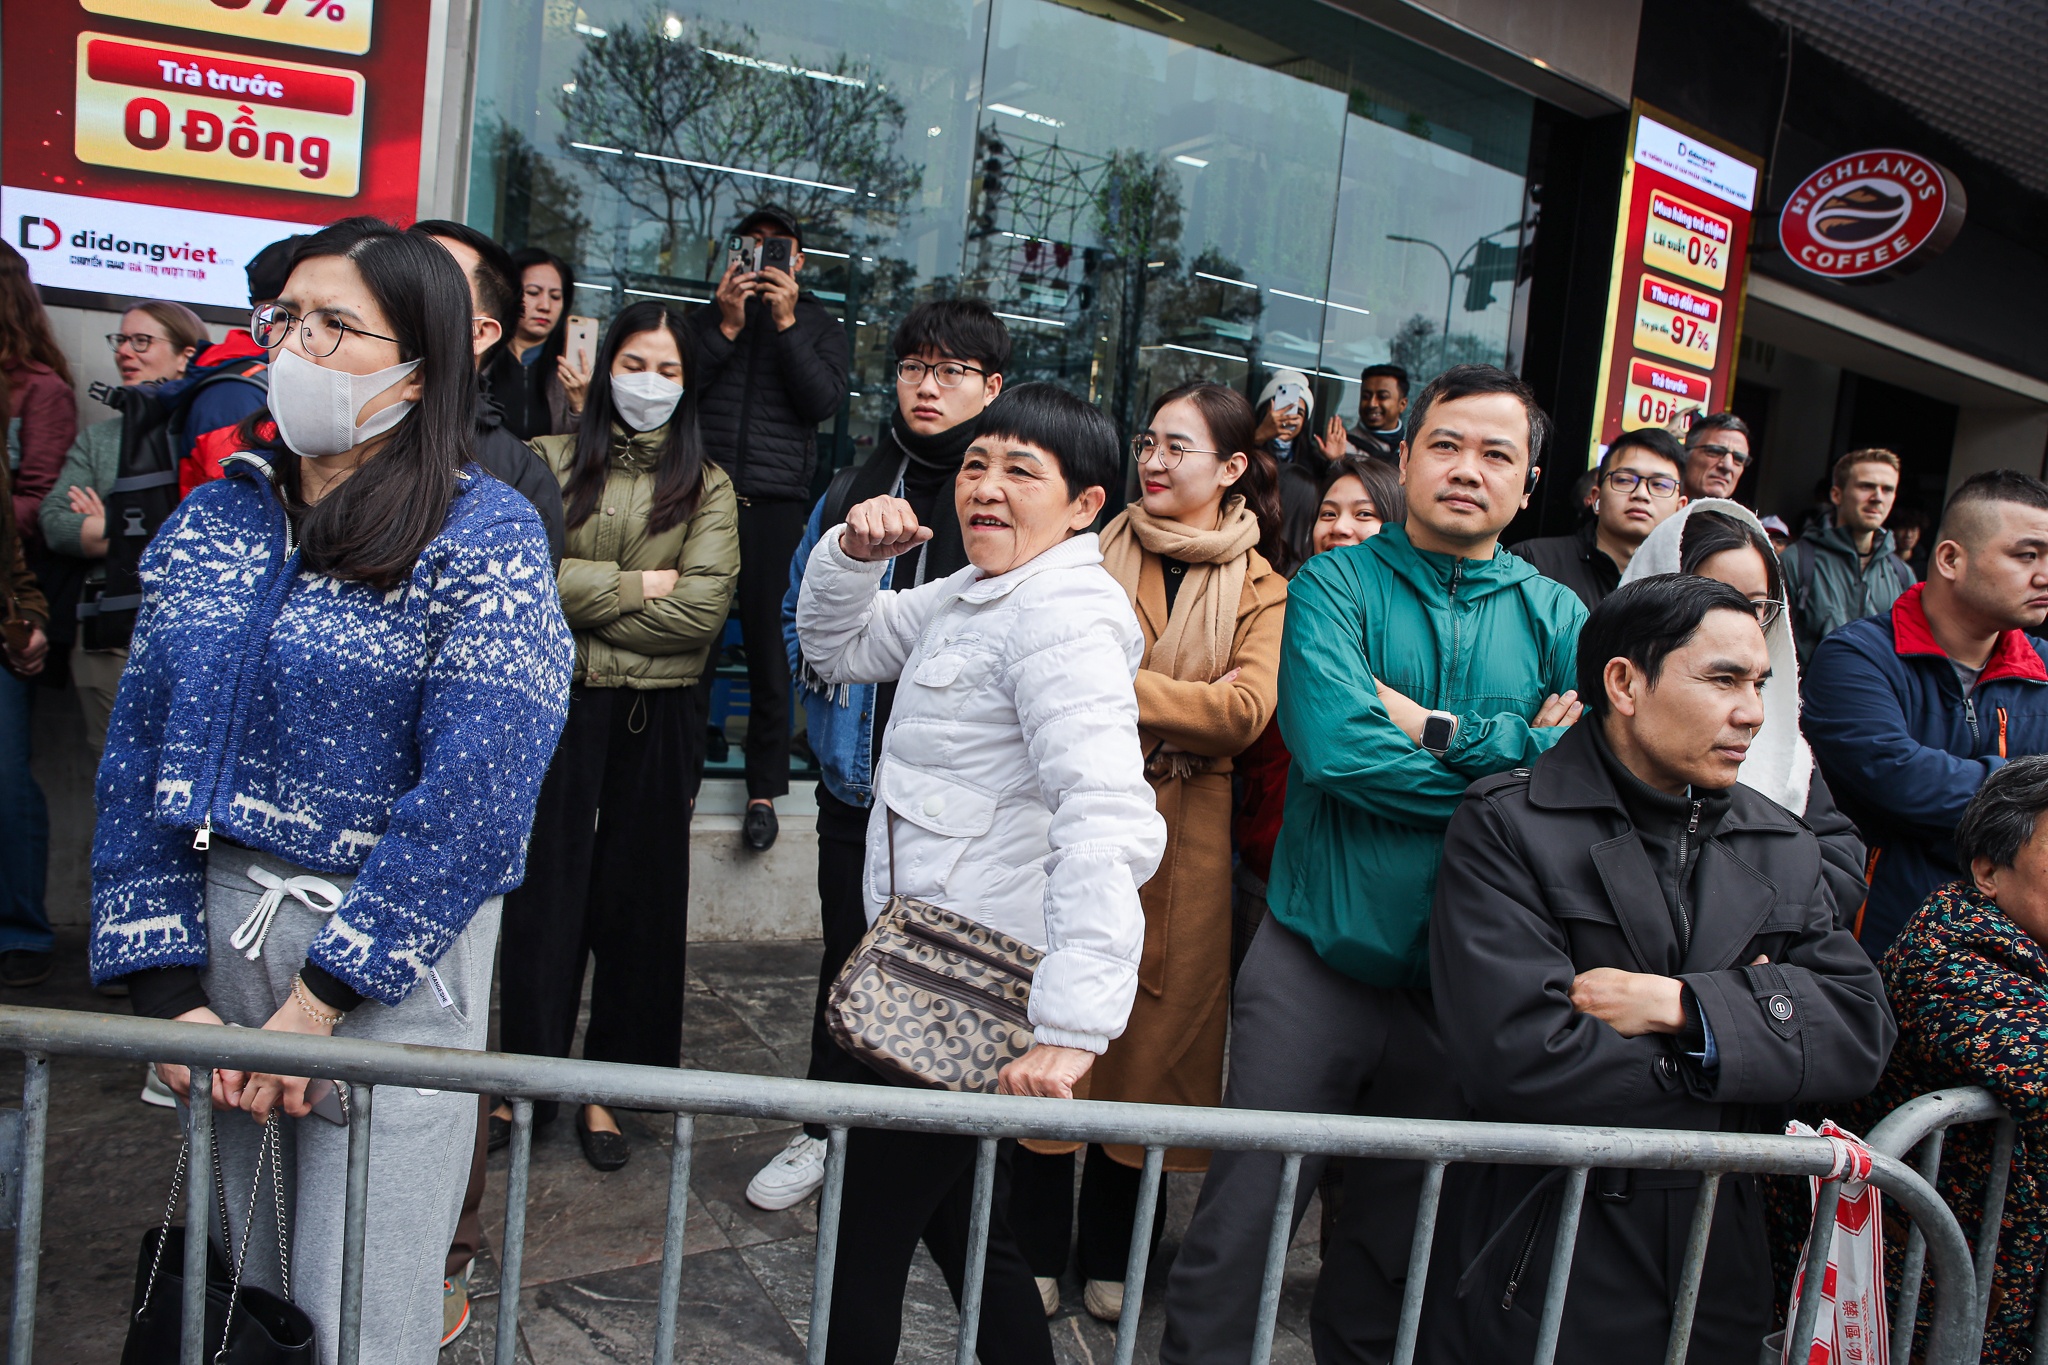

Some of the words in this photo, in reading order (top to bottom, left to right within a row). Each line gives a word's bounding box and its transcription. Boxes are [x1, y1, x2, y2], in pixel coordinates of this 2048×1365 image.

[158, 60, 202, 87] Trả
[207, 66, 284, 98] trước
[125, 97, 171, 151] 0
[181, 104, 331, 180] Đồng
[1791, 157, 1937, 215] HIGHLANDS
[1653, 199, 1672, 219] Mua
[1672, 206, 1692, 230] hàng
[1688, 236, 1718, 269] 0%
[1800, 234, 1911, 271] COFFEE
[1651, 285, 1668, 304] Thu
[1668, 293, 1680, 308] cũ
[1671, 315, 1709, 351] 97%
[1651, 372, 1665, 388] Trả
[1665, 378, 1688, 395] trước
[1639, 394, 1653, 423] 0
